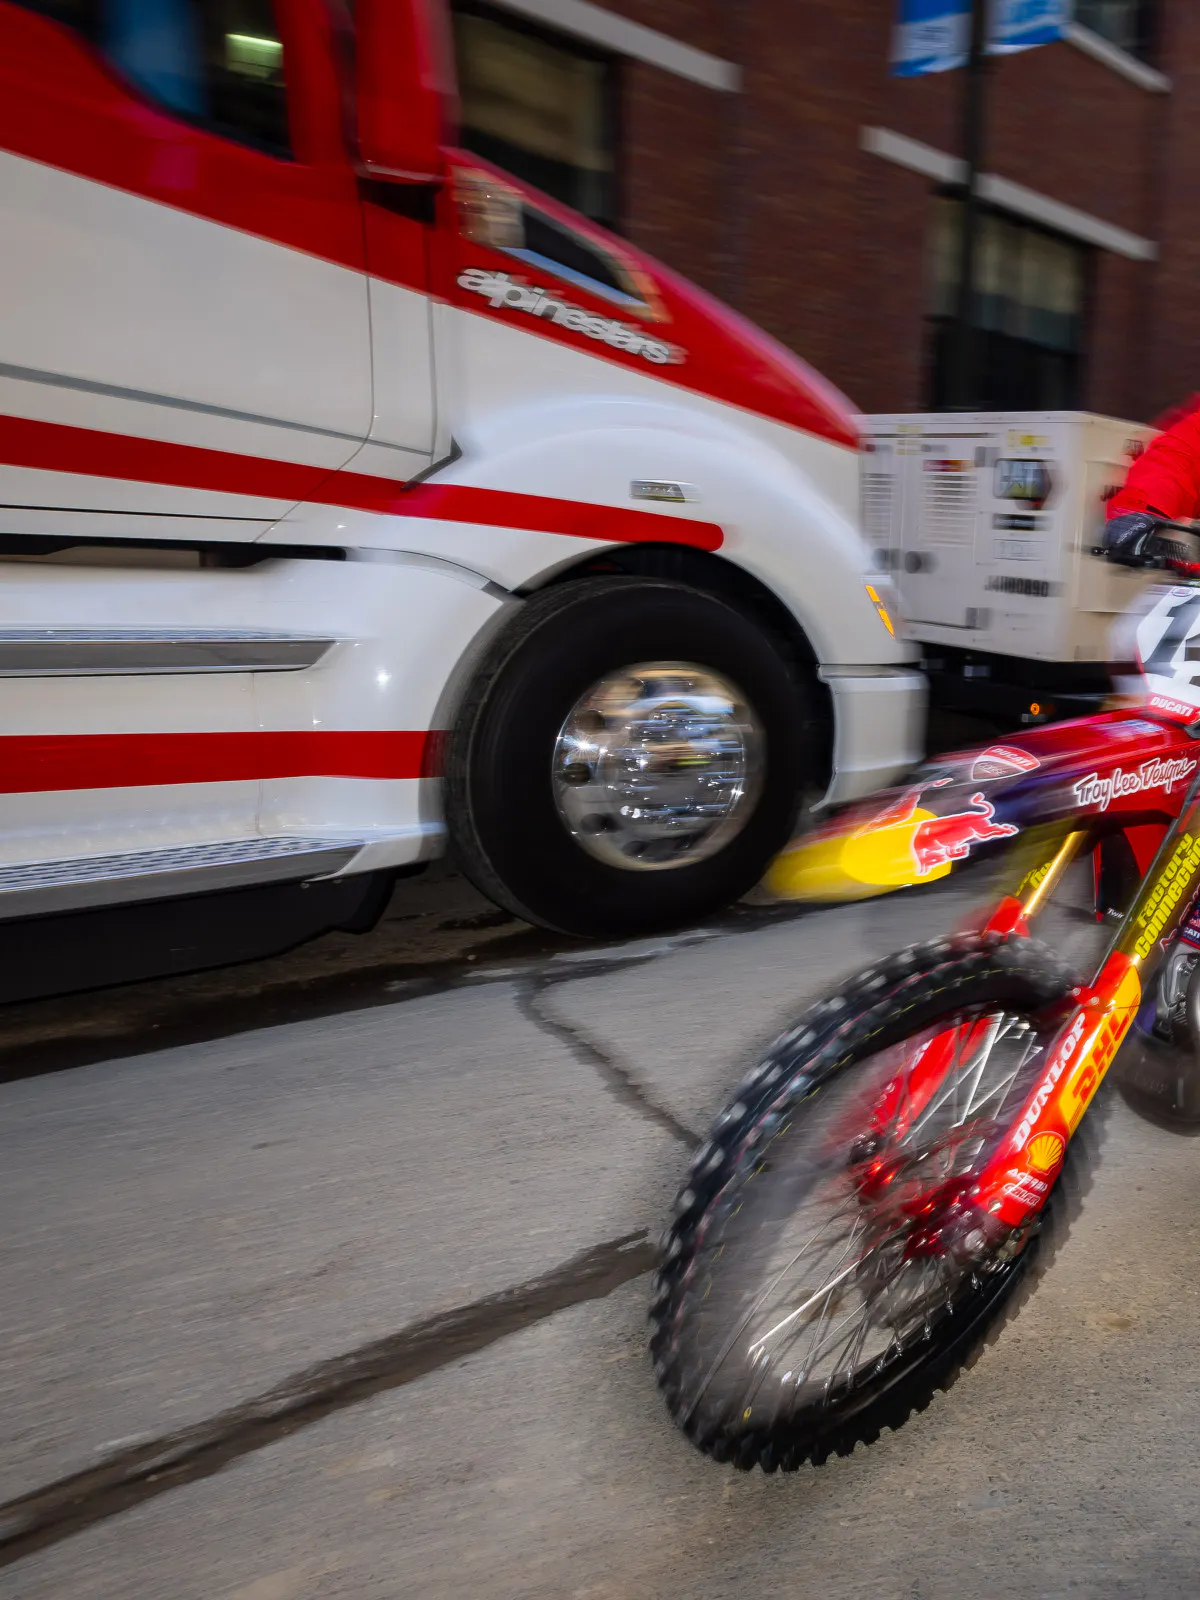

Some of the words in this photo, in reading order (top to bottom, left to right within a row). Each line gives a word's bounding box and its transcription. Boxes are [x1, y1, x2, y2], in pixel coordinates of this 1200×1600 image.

[457, 268, 672, 364] alpinestars
[1150, 696, 1194, 717] DUCATI
[991, 748, 1036, 767] DUCATI
[1073, 772, 1112, 812] Troy
[1111, 767, 1142, 799] Lee
[1140, 757, 1198, 795] Designs
[1012, 1012, 1087, 1152] DUNLOP
[1072, 1012, 1130, 1105] DHL
